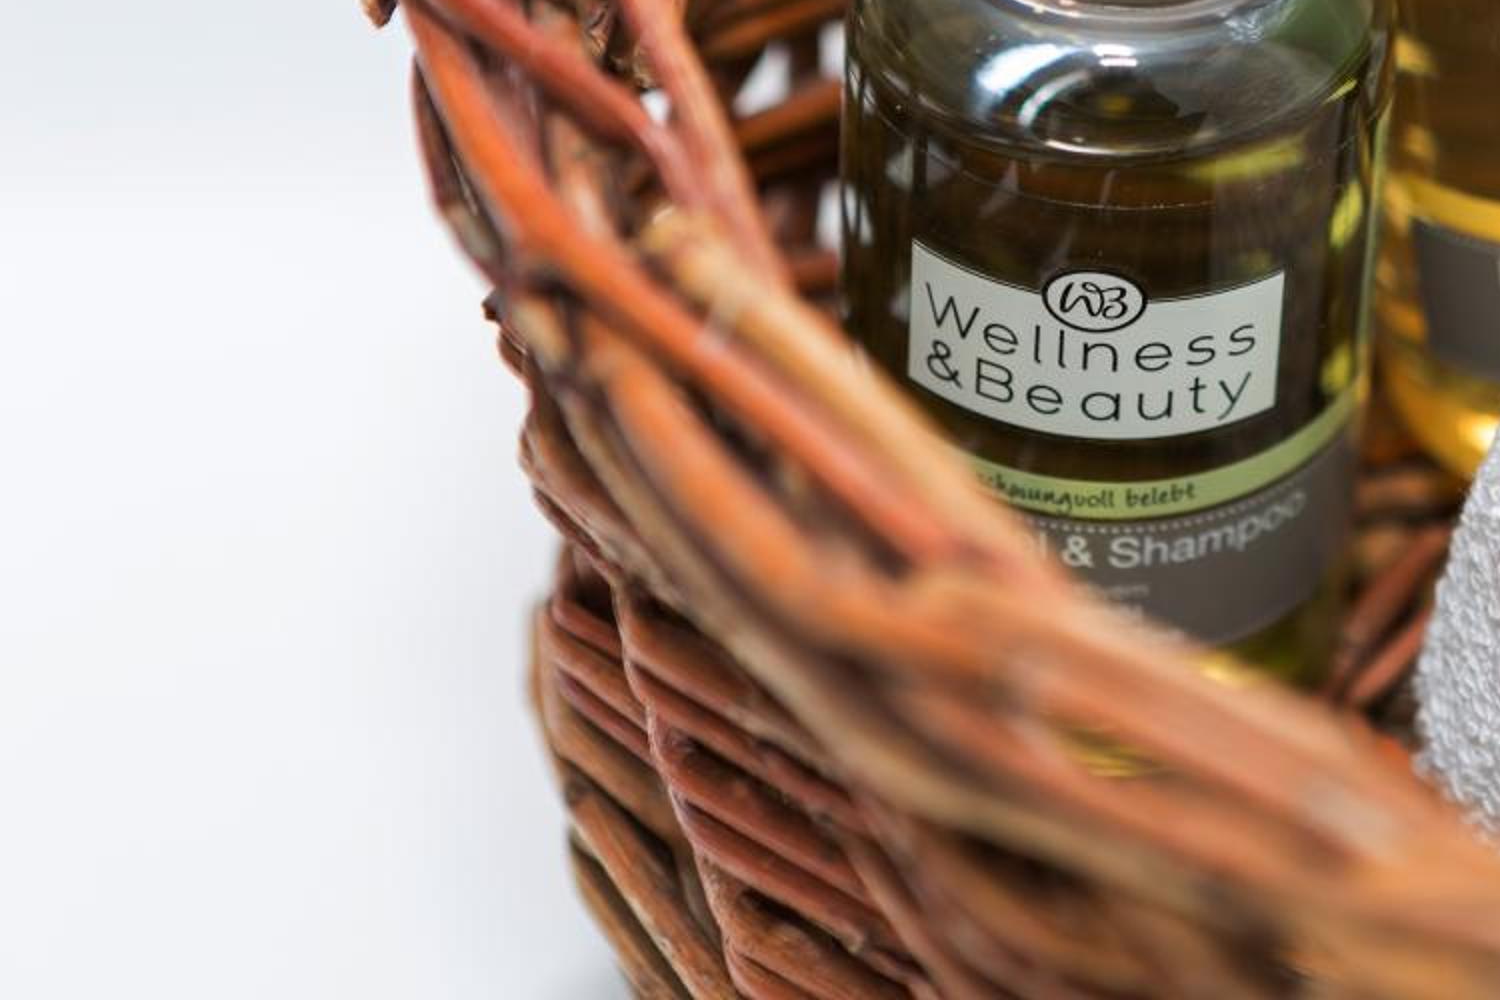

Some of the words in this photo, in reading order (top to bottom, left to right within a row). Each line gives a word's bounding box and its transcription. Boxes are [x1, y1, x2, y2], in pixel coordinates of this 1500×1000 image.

[925, 281, 1257, 372] Wellness
[1061, 534, 1094, 569] &
[1108, 491, 1307, 569] Shampoo
[1125, 482, 1197, 508] belebt
